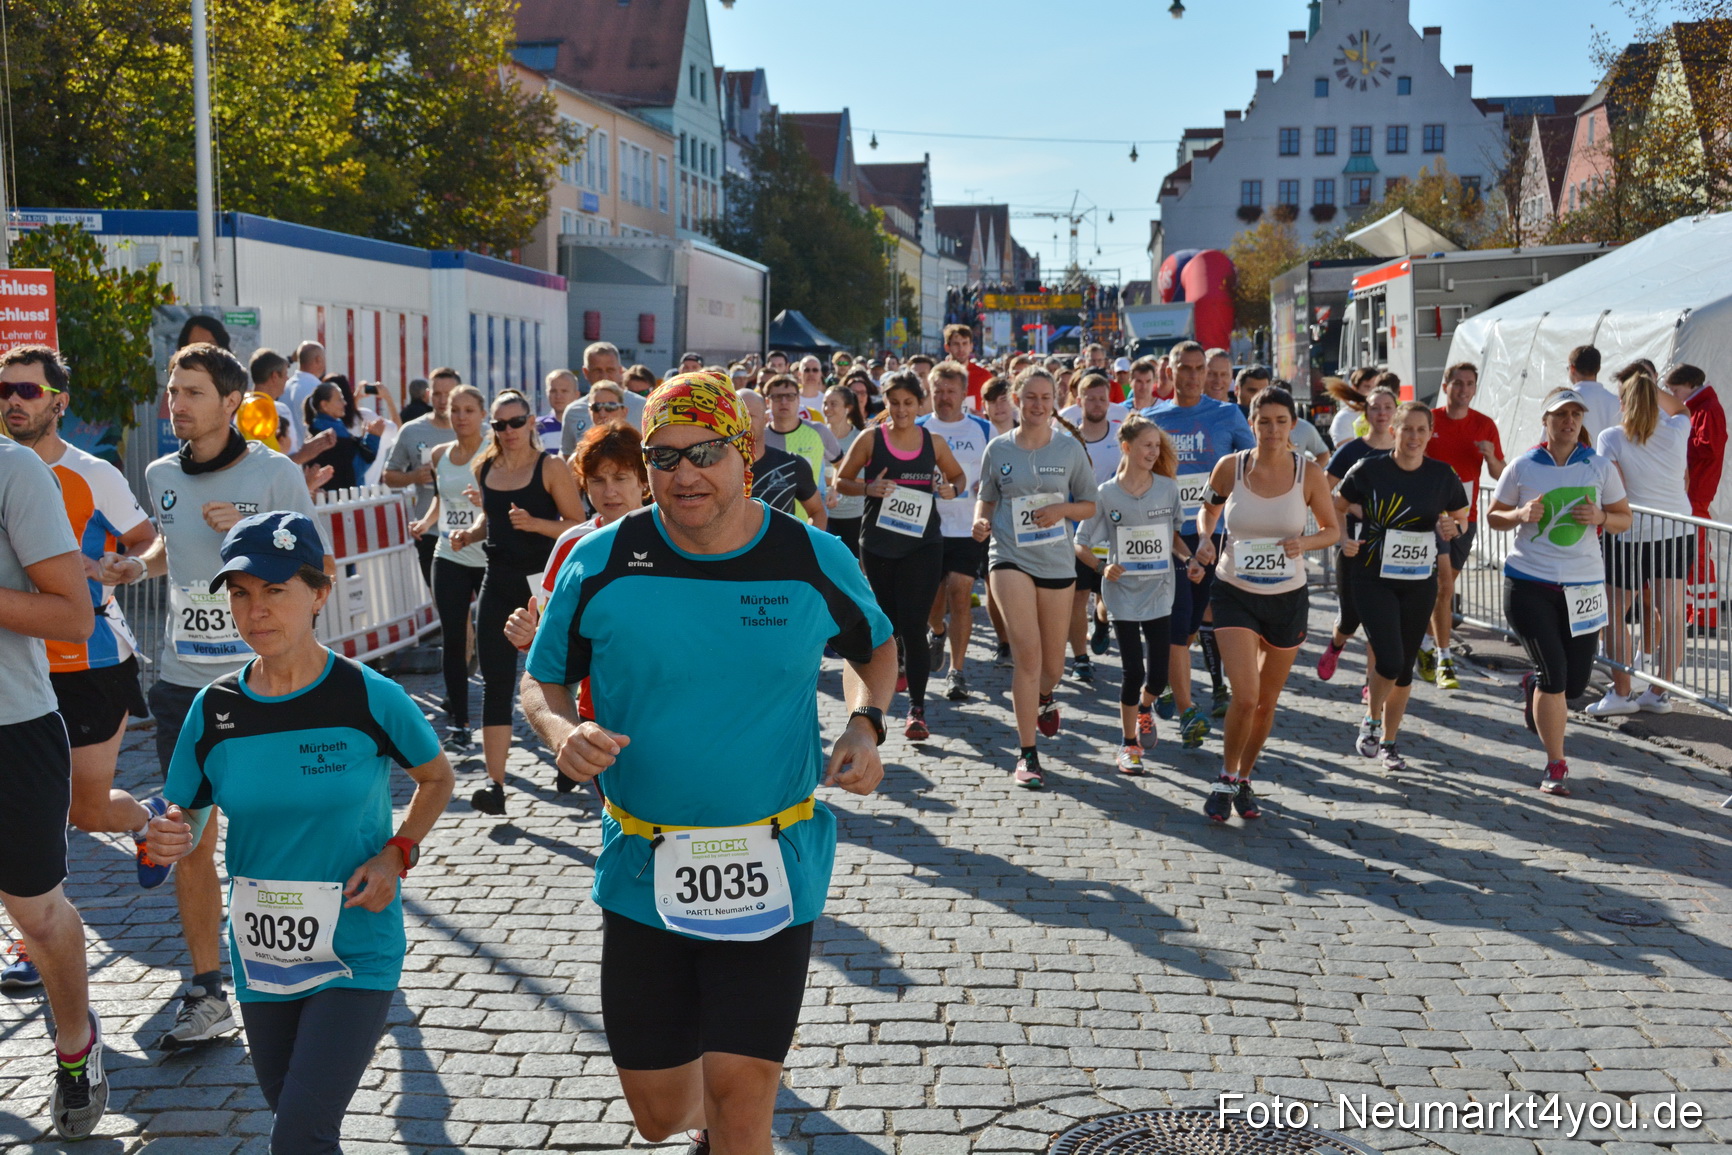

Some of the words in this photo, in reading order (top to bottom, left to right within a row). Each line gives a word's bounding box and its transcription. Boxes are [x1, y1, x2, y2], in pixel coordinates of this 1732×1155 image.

[0, 279, 48, 296] hluss
[2, 330, 32, 340] Lehrer
[34, 330, 47, 340] für
[1177, 452, 1196, 461] ULL
[1180, 487, 1203, 502] 02
[888, 498, 922, 518] 2081
[446, 510, 474, 525] 2321
[1126, 539, 1162, 555] 2068
[1392, 544, 1428, 560] 2554
[1244, 553, 1286, 570] 2254
[740, 595, 789, 605] Mürbeth
[758, 606, 766, 616] &
[740, 616, 788, 626] Tischler
[193, 644, 236, 654] Veronika
[299, 741, 348, 754] Mürbeth
[317, 754, 325, 764] &
[301, 763, 347, 776] Tischler
[692, 838, 748, 854] BOCK
[675, 861, 769, 904] 3035
[258, 890, 304, 905] BOCK
[686, 908, 714, 916] PARTL
[716, 905, 754, 915] Neumarkt
[244, 912, 319, 952] 3039
[255, 952, 273, 960] PARTL
